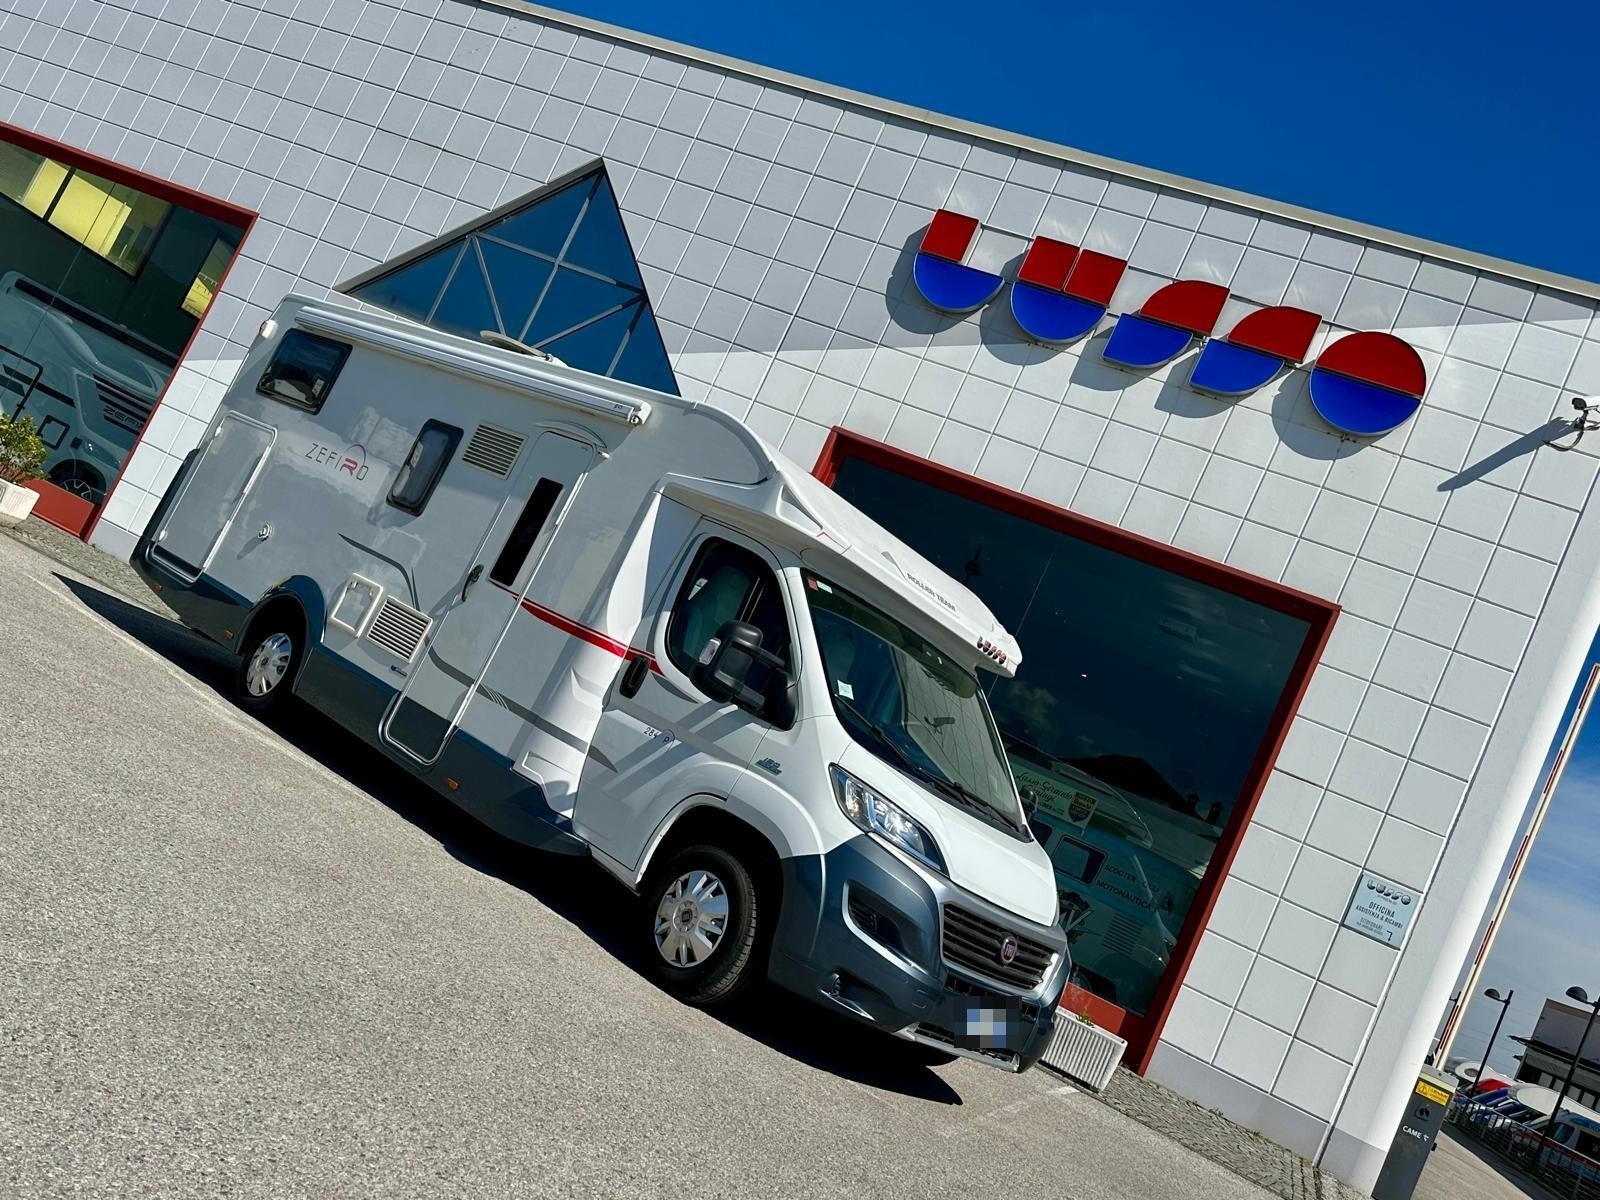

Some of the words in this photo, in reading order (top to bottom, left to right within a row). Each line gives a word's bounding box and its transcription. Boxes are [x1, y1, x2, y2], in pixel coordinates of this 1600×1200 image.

[305, 443, 369, 481] ZEFIRO
[906, 573, 936, 597] ROLLER
[936, 595, 957, 612] TEAM
[1105, 864, 1137, 881] SCOOTER
[1368, 901, 1396, 918] OFFICINA
[1402, 1125, 1422, 1139] CAME
